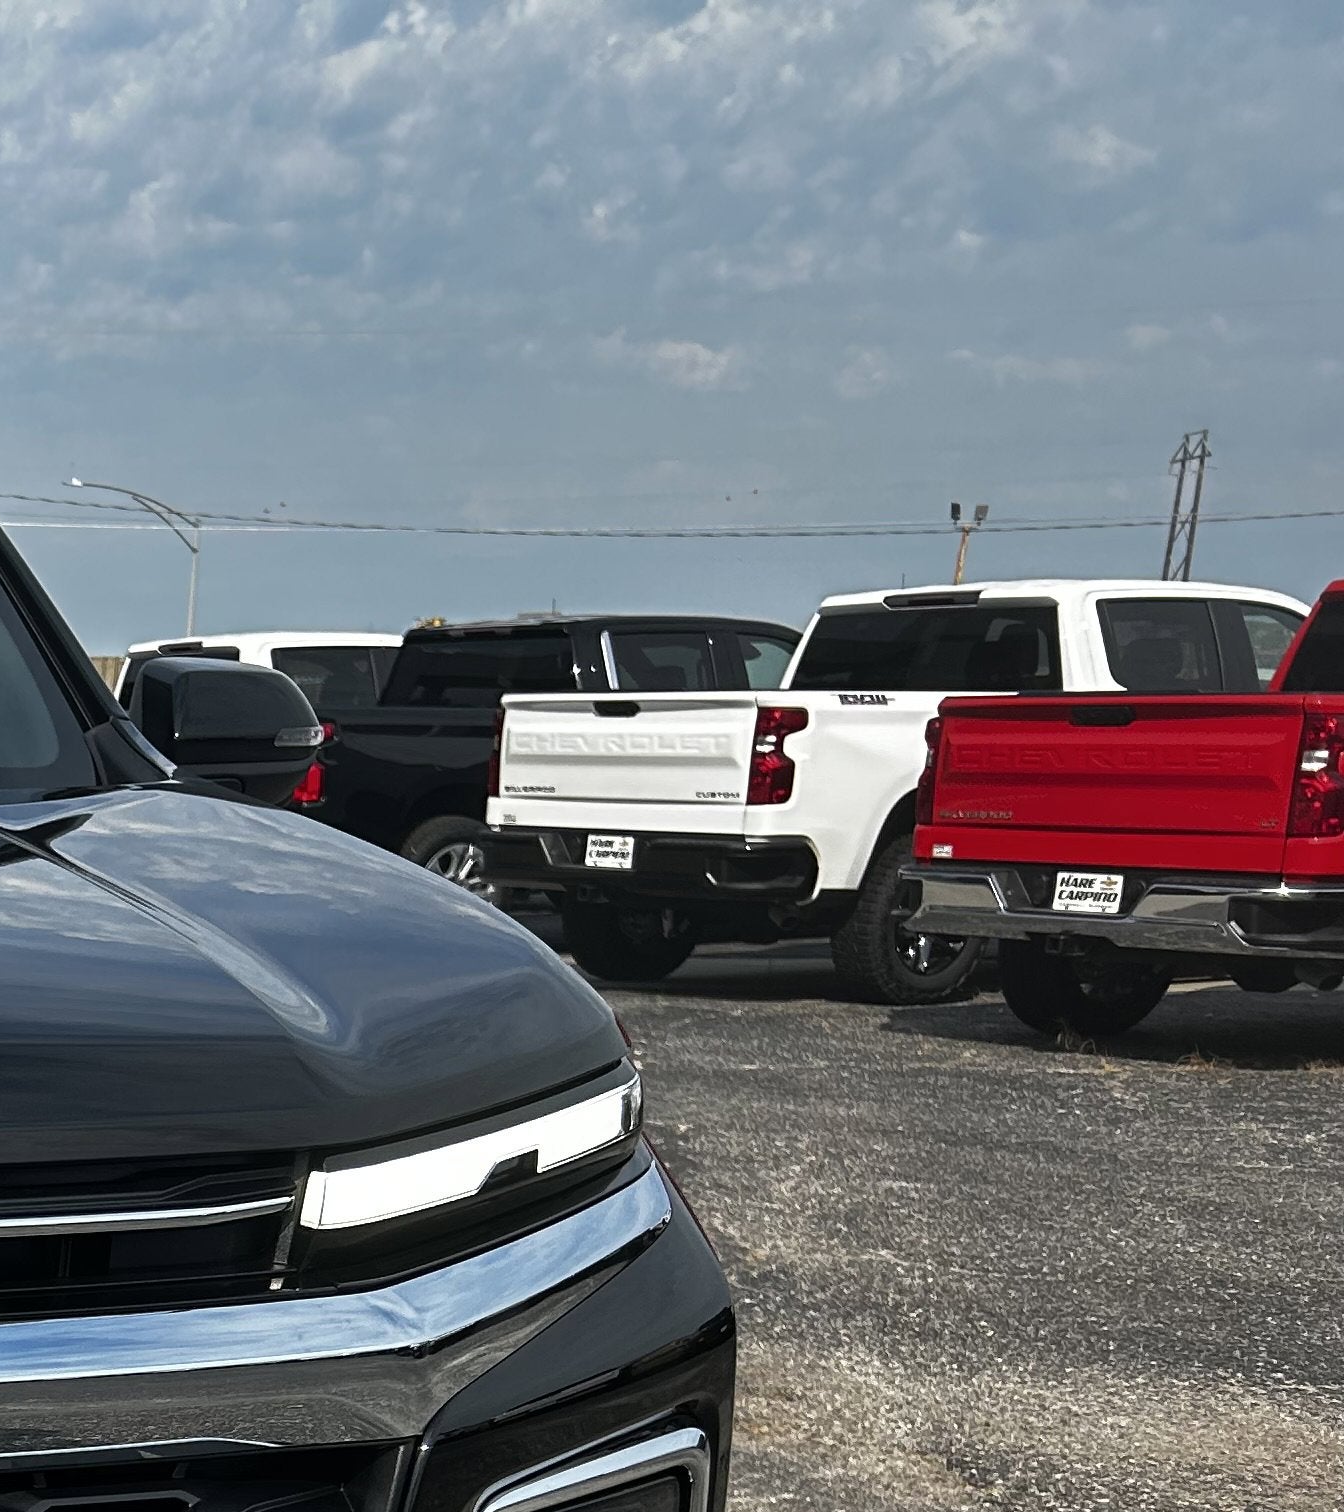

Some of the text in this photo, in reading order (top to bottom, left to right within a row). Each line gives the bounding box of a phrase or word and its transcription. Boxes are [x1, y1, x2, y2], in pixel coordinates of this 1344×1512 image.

[512, 732, 730, 754] CHEVROLET
[952, 748, 1263, 770] CHEVROLET
[1059, 875, 1097, 889] HARE
[1057, 889, 1119, 903] CARPINO
